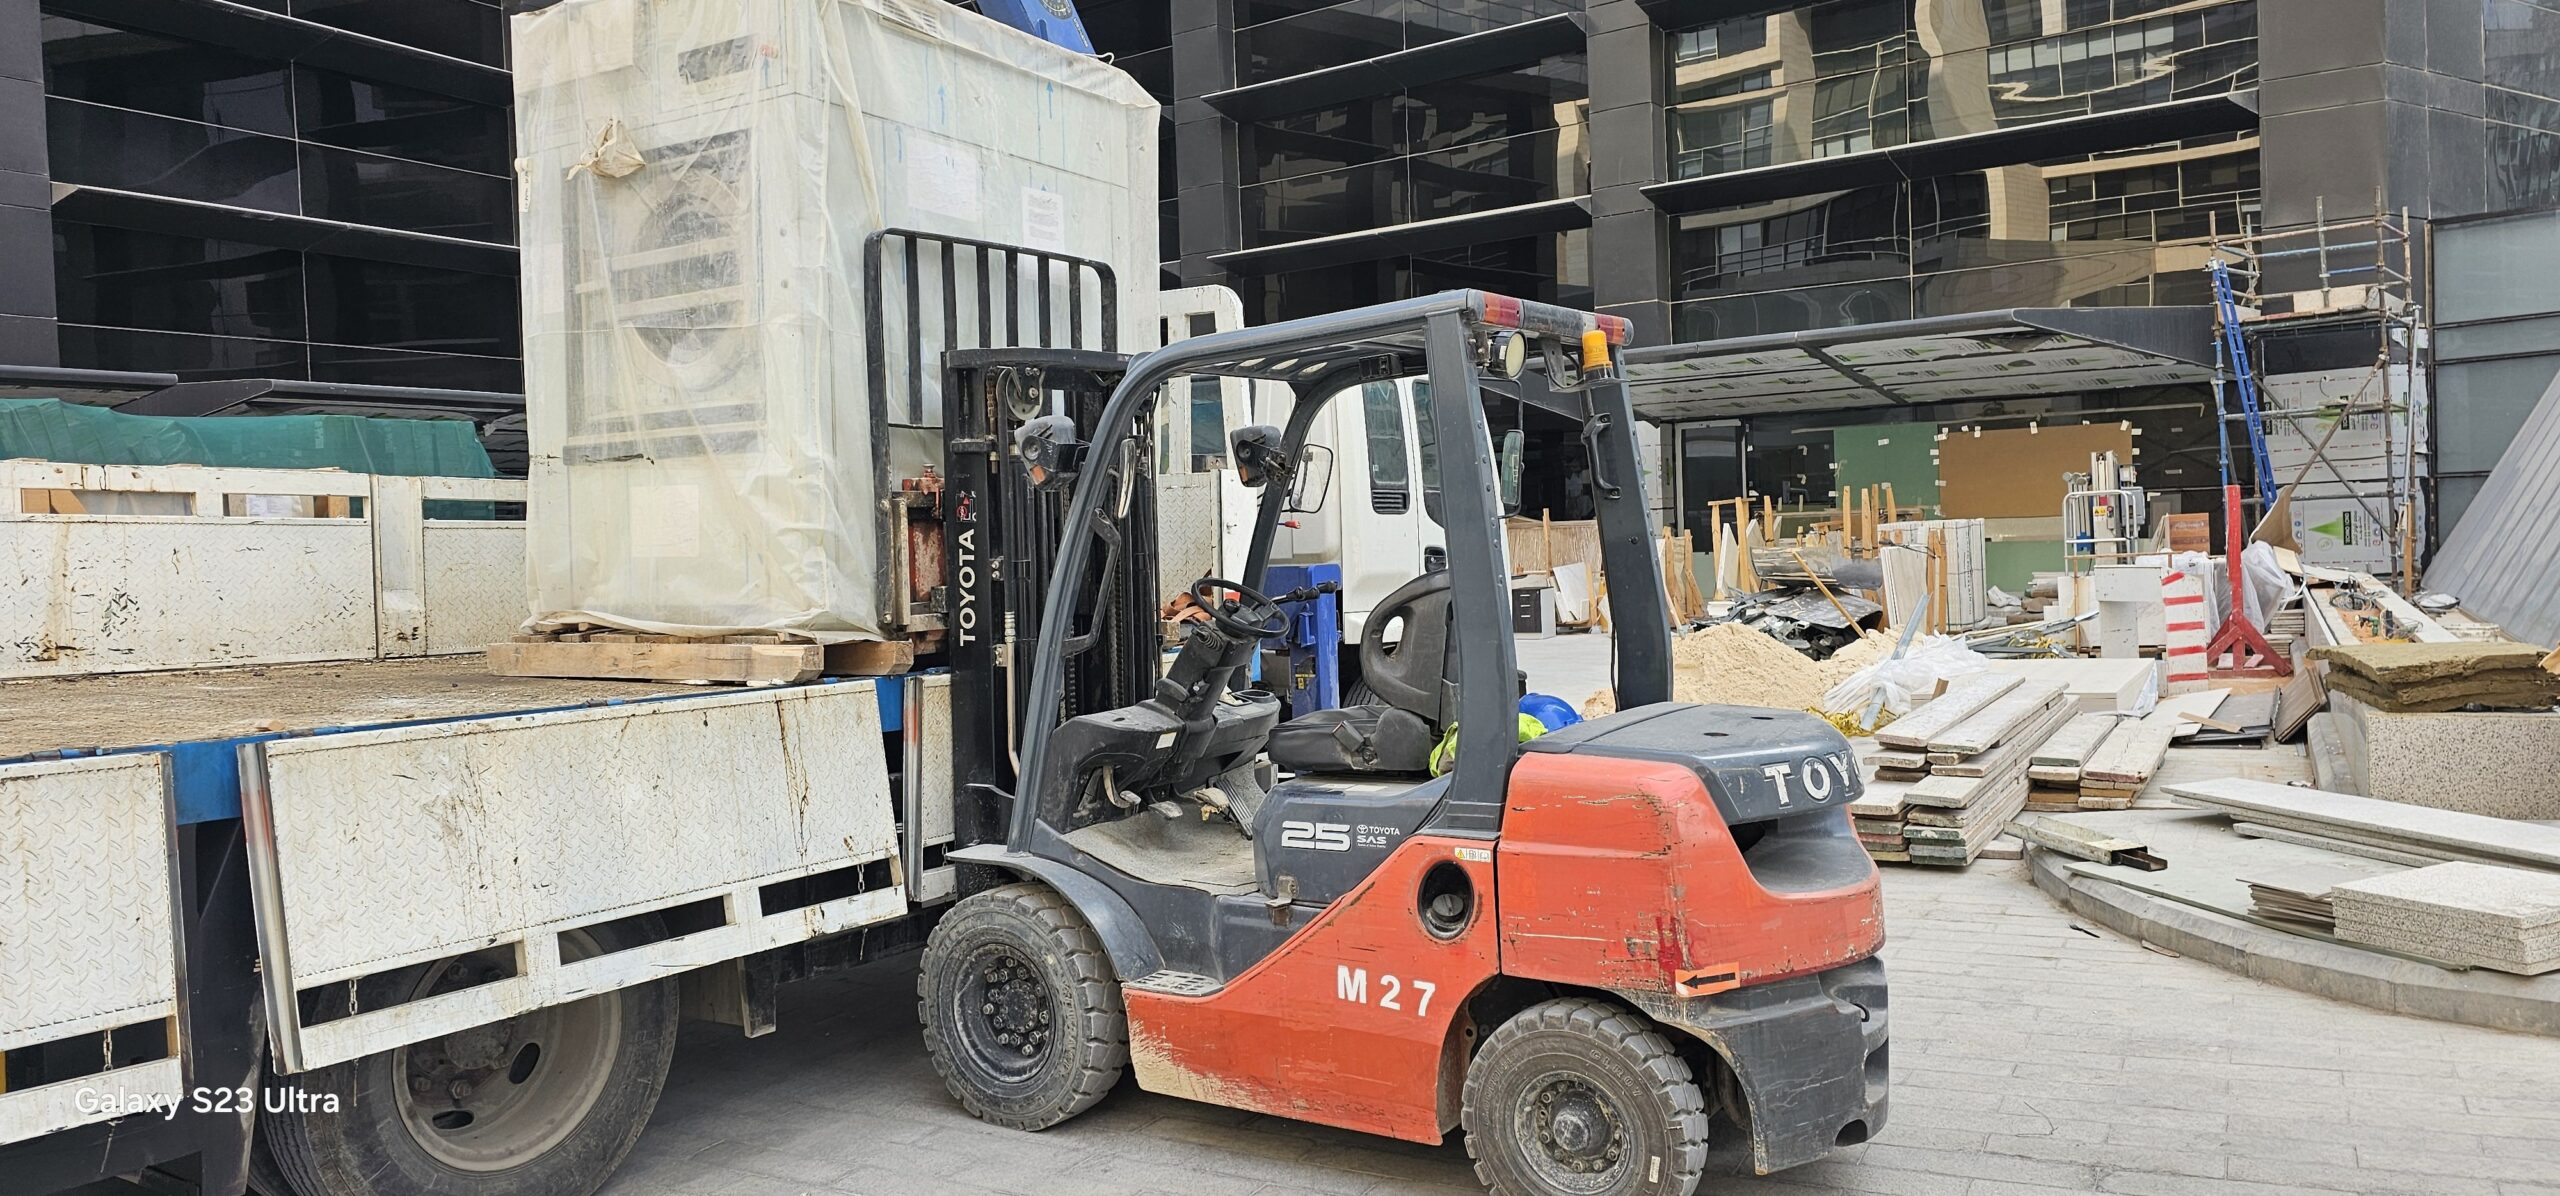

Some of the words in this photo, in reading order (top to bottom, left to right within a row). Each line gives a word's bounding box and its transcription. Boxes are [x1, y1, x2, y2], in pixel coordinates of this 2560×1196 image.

[959, 528, 976, 647] TOYOTA
[1281, 821, 1350, 852] 25
[1357, 835, 1387, 844] SAS
[1369, 826, 1400, 836] TOYOTA
